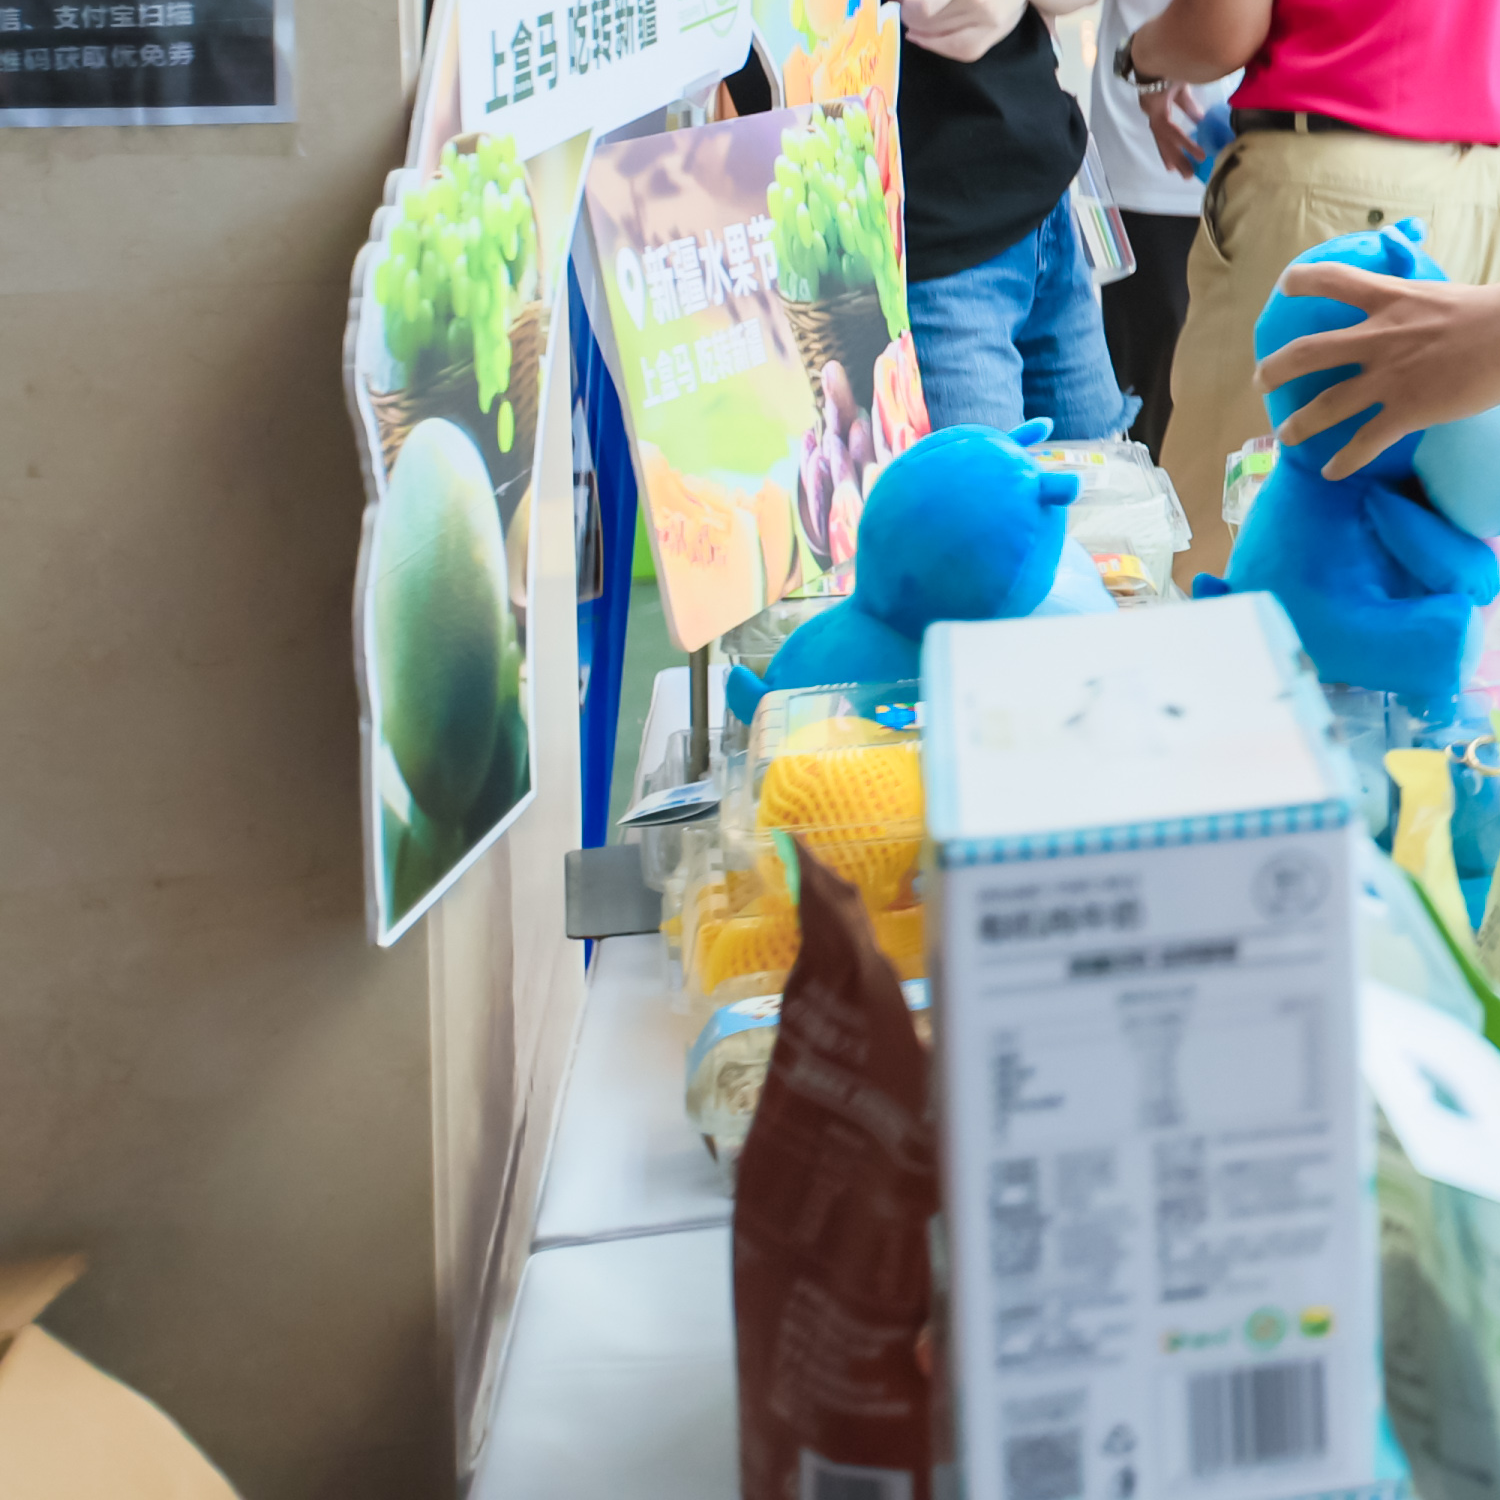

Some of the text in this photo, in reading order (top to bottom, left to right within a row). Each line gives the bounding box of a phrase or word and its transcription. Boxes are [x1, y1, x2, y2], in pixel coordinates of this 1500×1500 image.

[485, 11, 557, 114] 上盒马
[641, 214, 778, 325] 新疆水果节
[640, 317, 768, 409] 上盒马 吃转新疆
